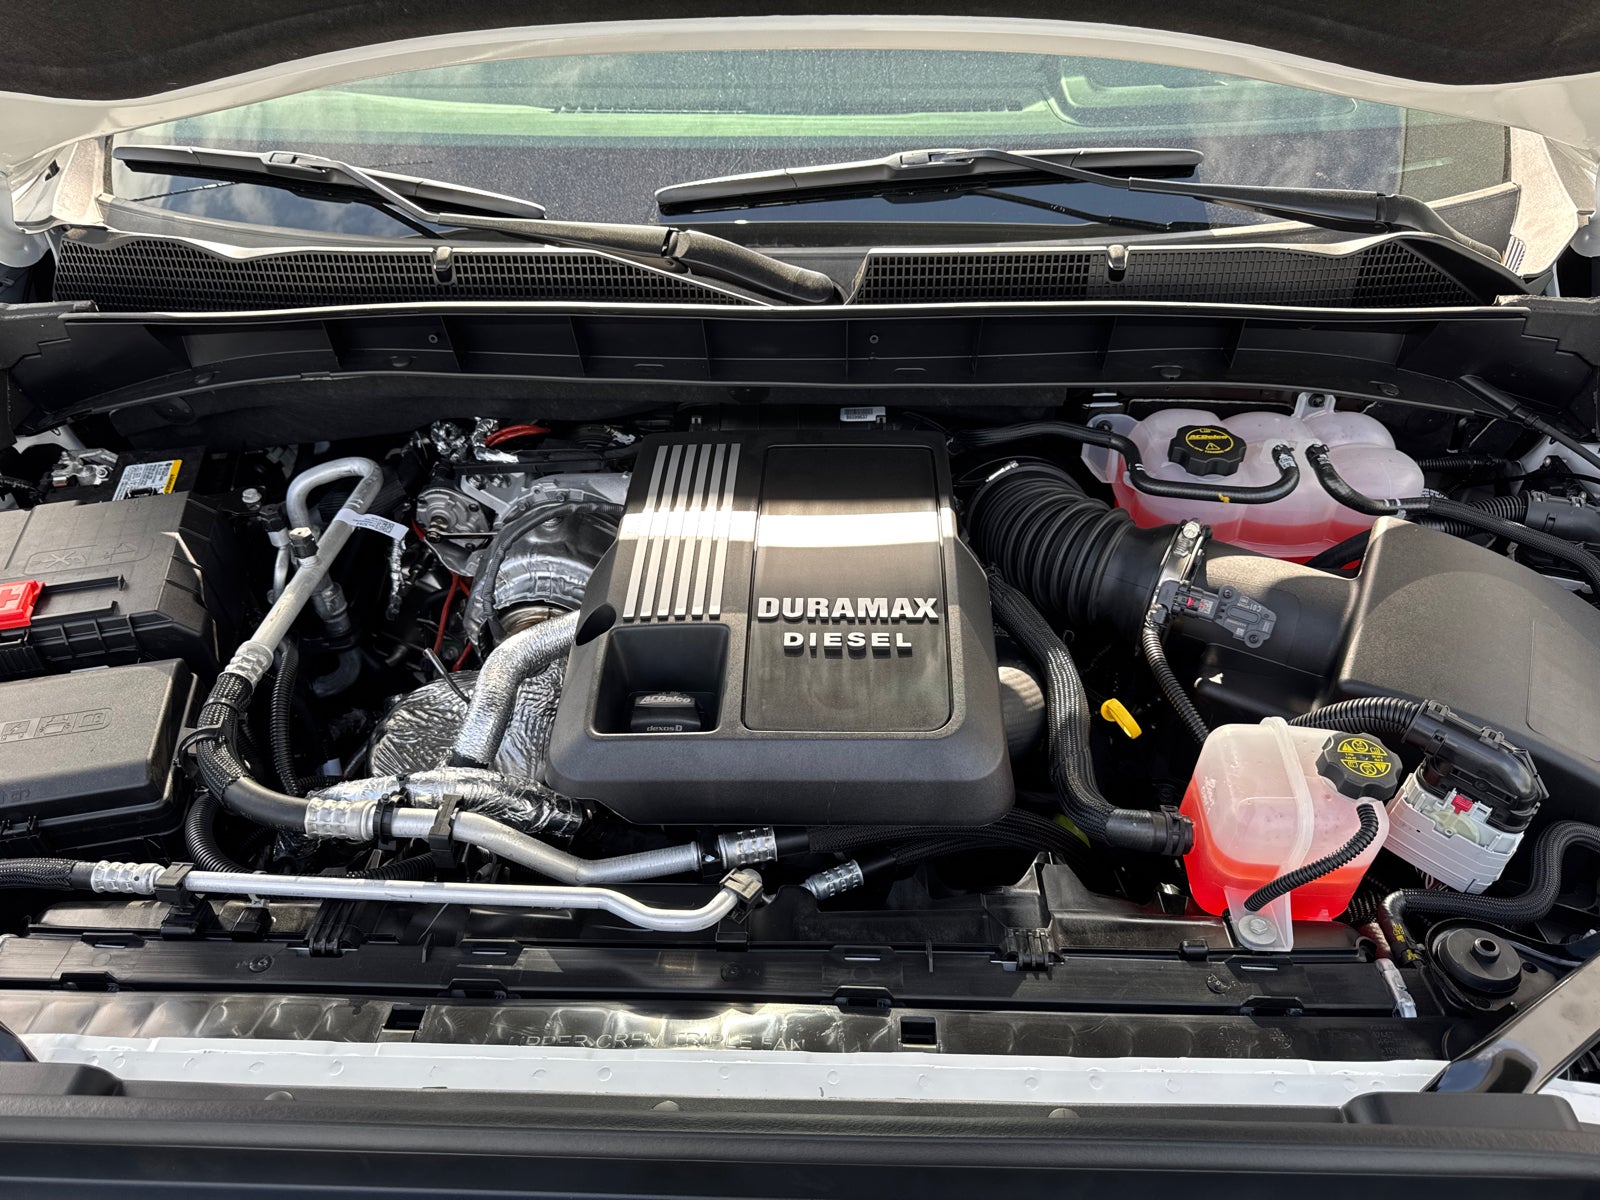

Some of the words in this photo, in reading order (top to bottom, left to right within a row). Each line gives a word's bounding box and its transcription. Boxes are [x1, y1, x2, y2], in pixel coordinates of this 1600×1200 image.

[757, 597, 939, 621] DURAMAX
[783, 632, 913, 650] DIESEL
[639, 695, 691, 704] ACDelco
